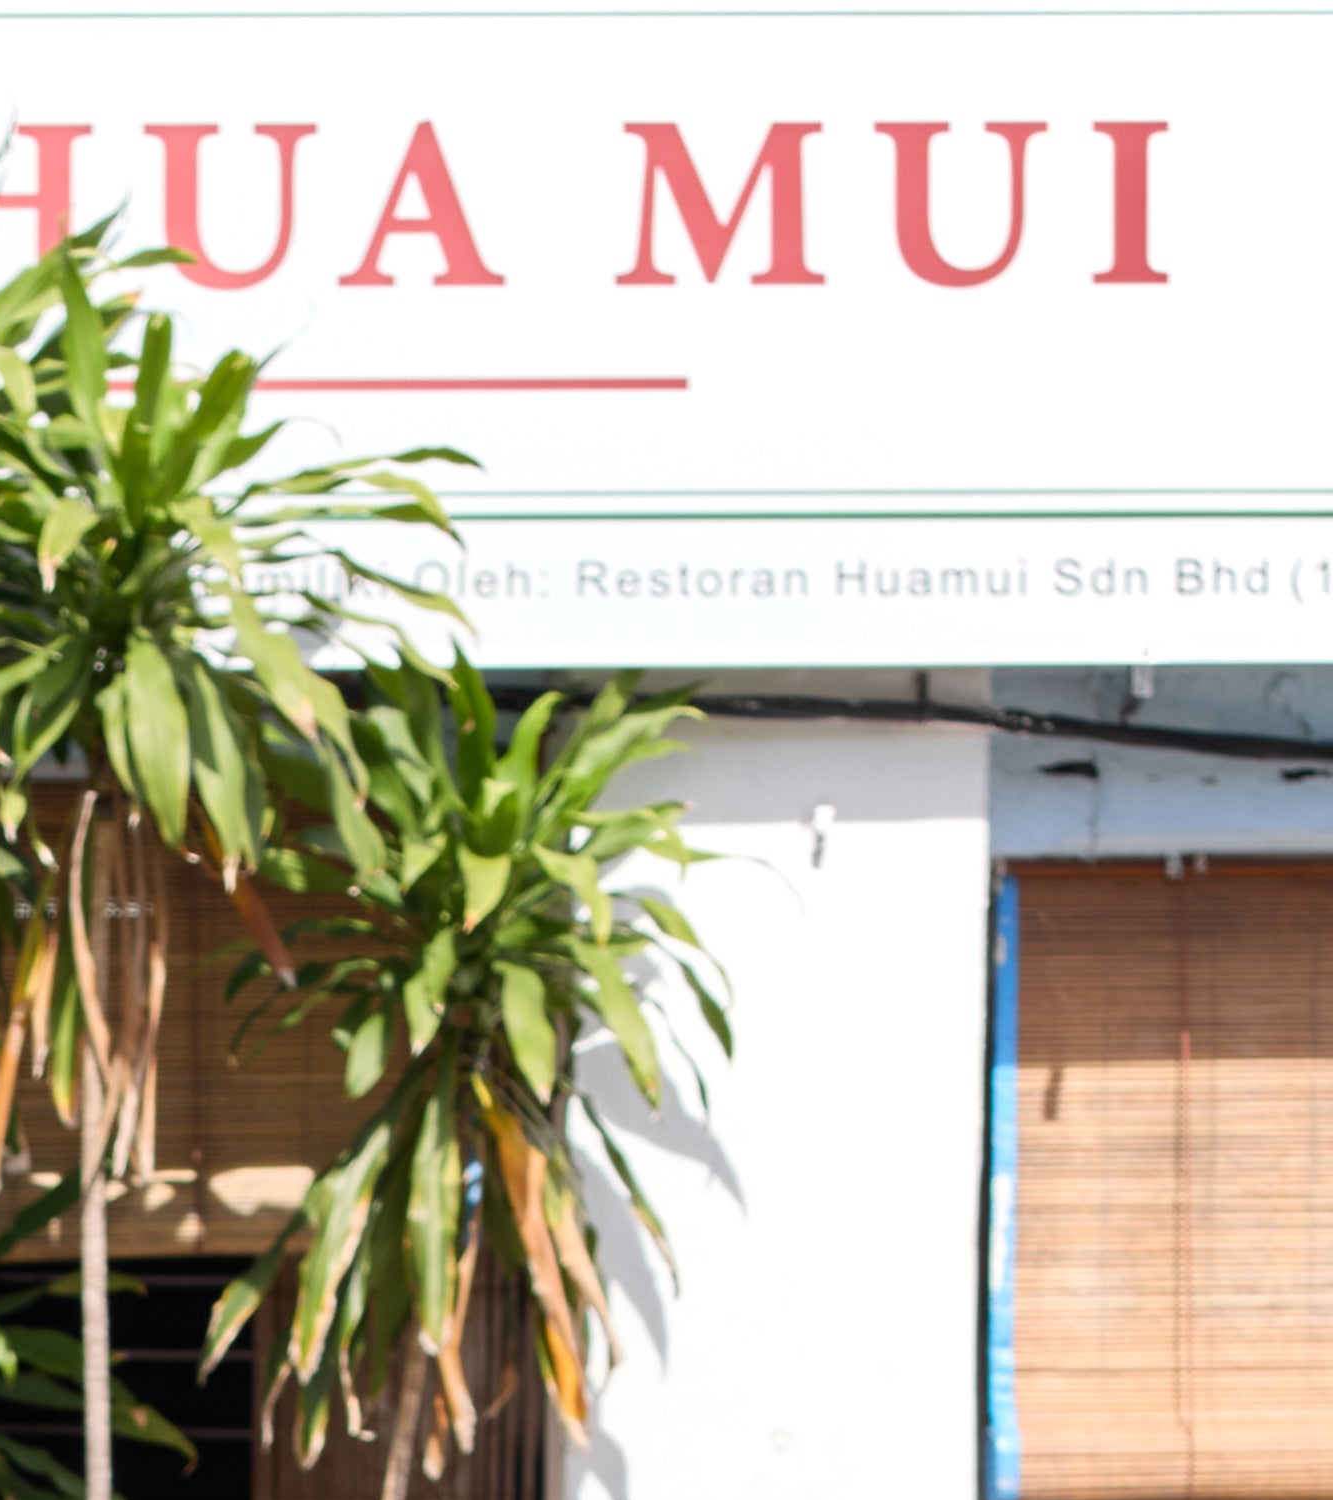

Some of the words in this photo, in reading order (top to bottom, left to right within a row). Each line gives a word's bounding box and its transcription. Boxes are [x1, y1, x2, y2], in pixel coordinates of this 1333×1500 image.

[614, 119, 1170, 289] MUI
[414, 557, 550, 599] Oleh:
[574, 557, 811, 599] Restoran
[833, 557, 1029, 599] Huamui
[1051, 556, 1151, 598] Sdn
[1172, 556, 1271, 598] Bhd
